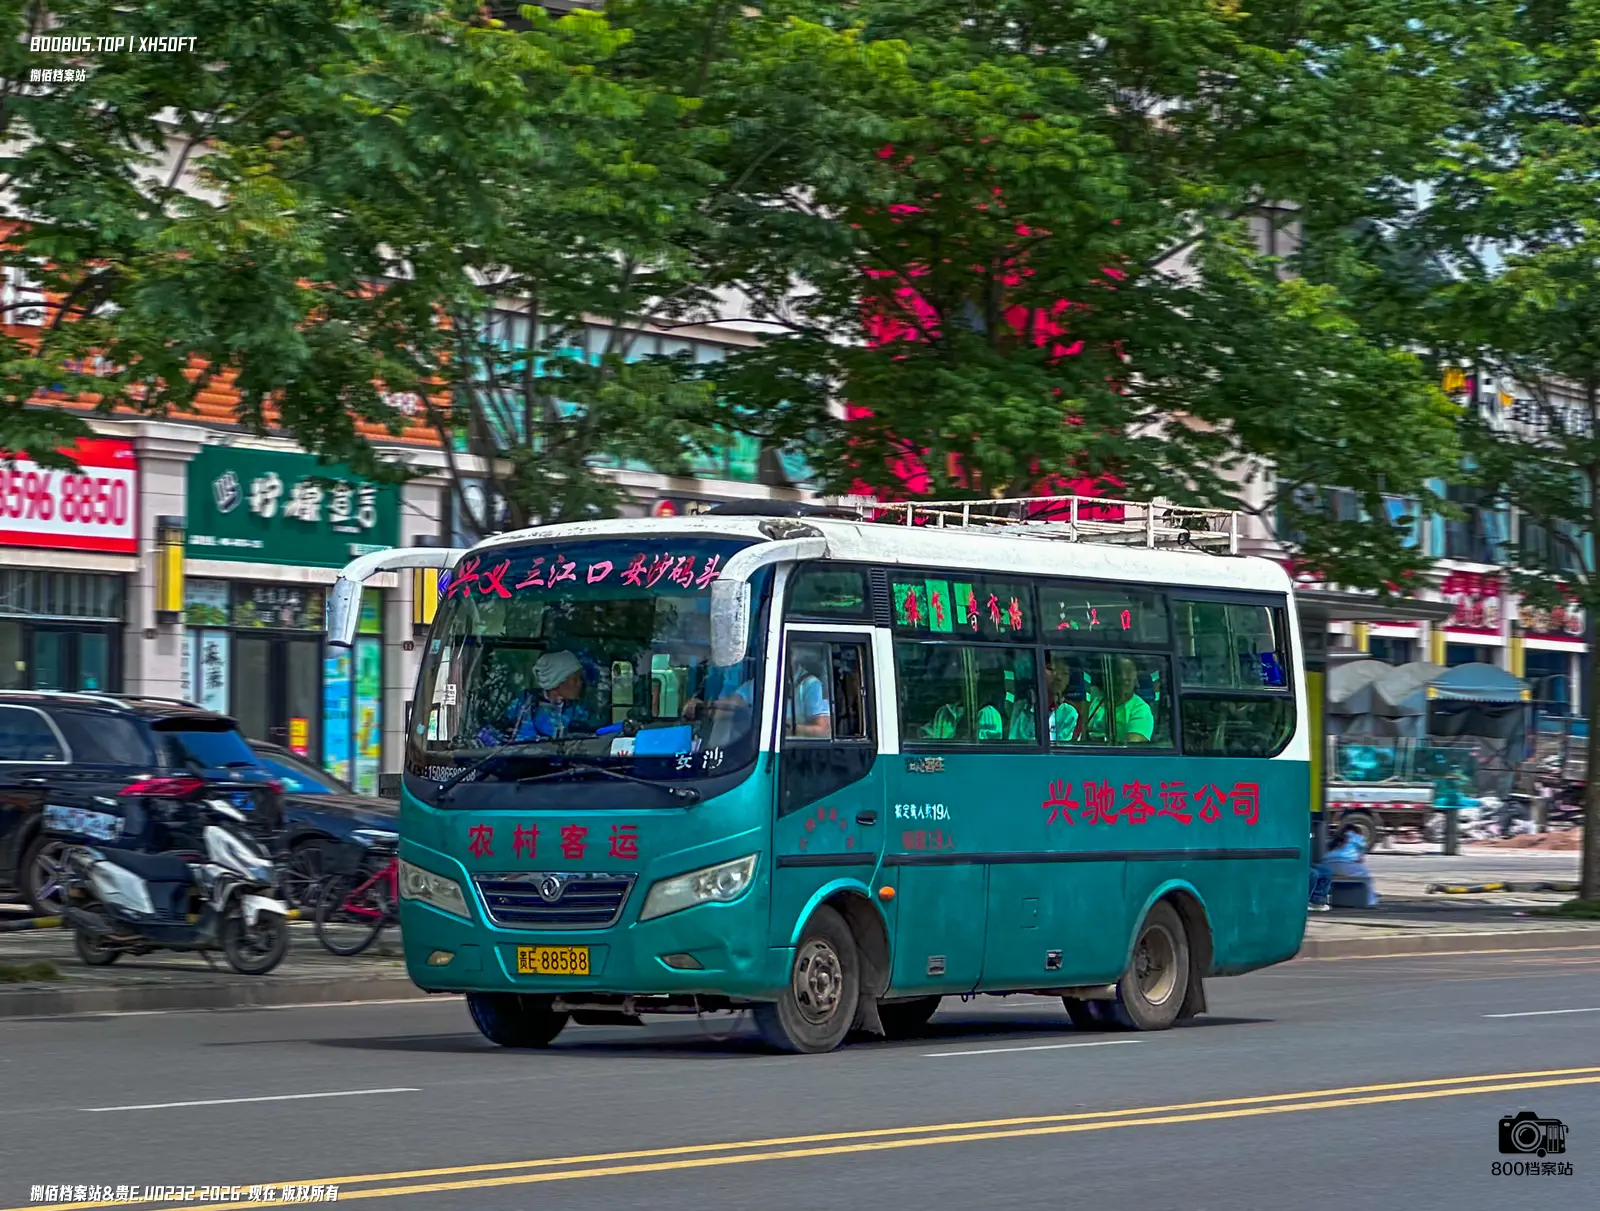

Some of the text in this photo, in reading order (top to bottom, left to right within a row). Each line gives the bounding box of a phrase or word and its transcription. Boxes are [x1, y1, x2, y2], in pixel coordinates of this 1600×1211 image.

[60, 474, 128, 526] 8850
[448, 555, 512, 600] 兴义
[1041, 778, 1261, 826] 兴驰客运公司
[468, 823, 639, 860] 农村客运
